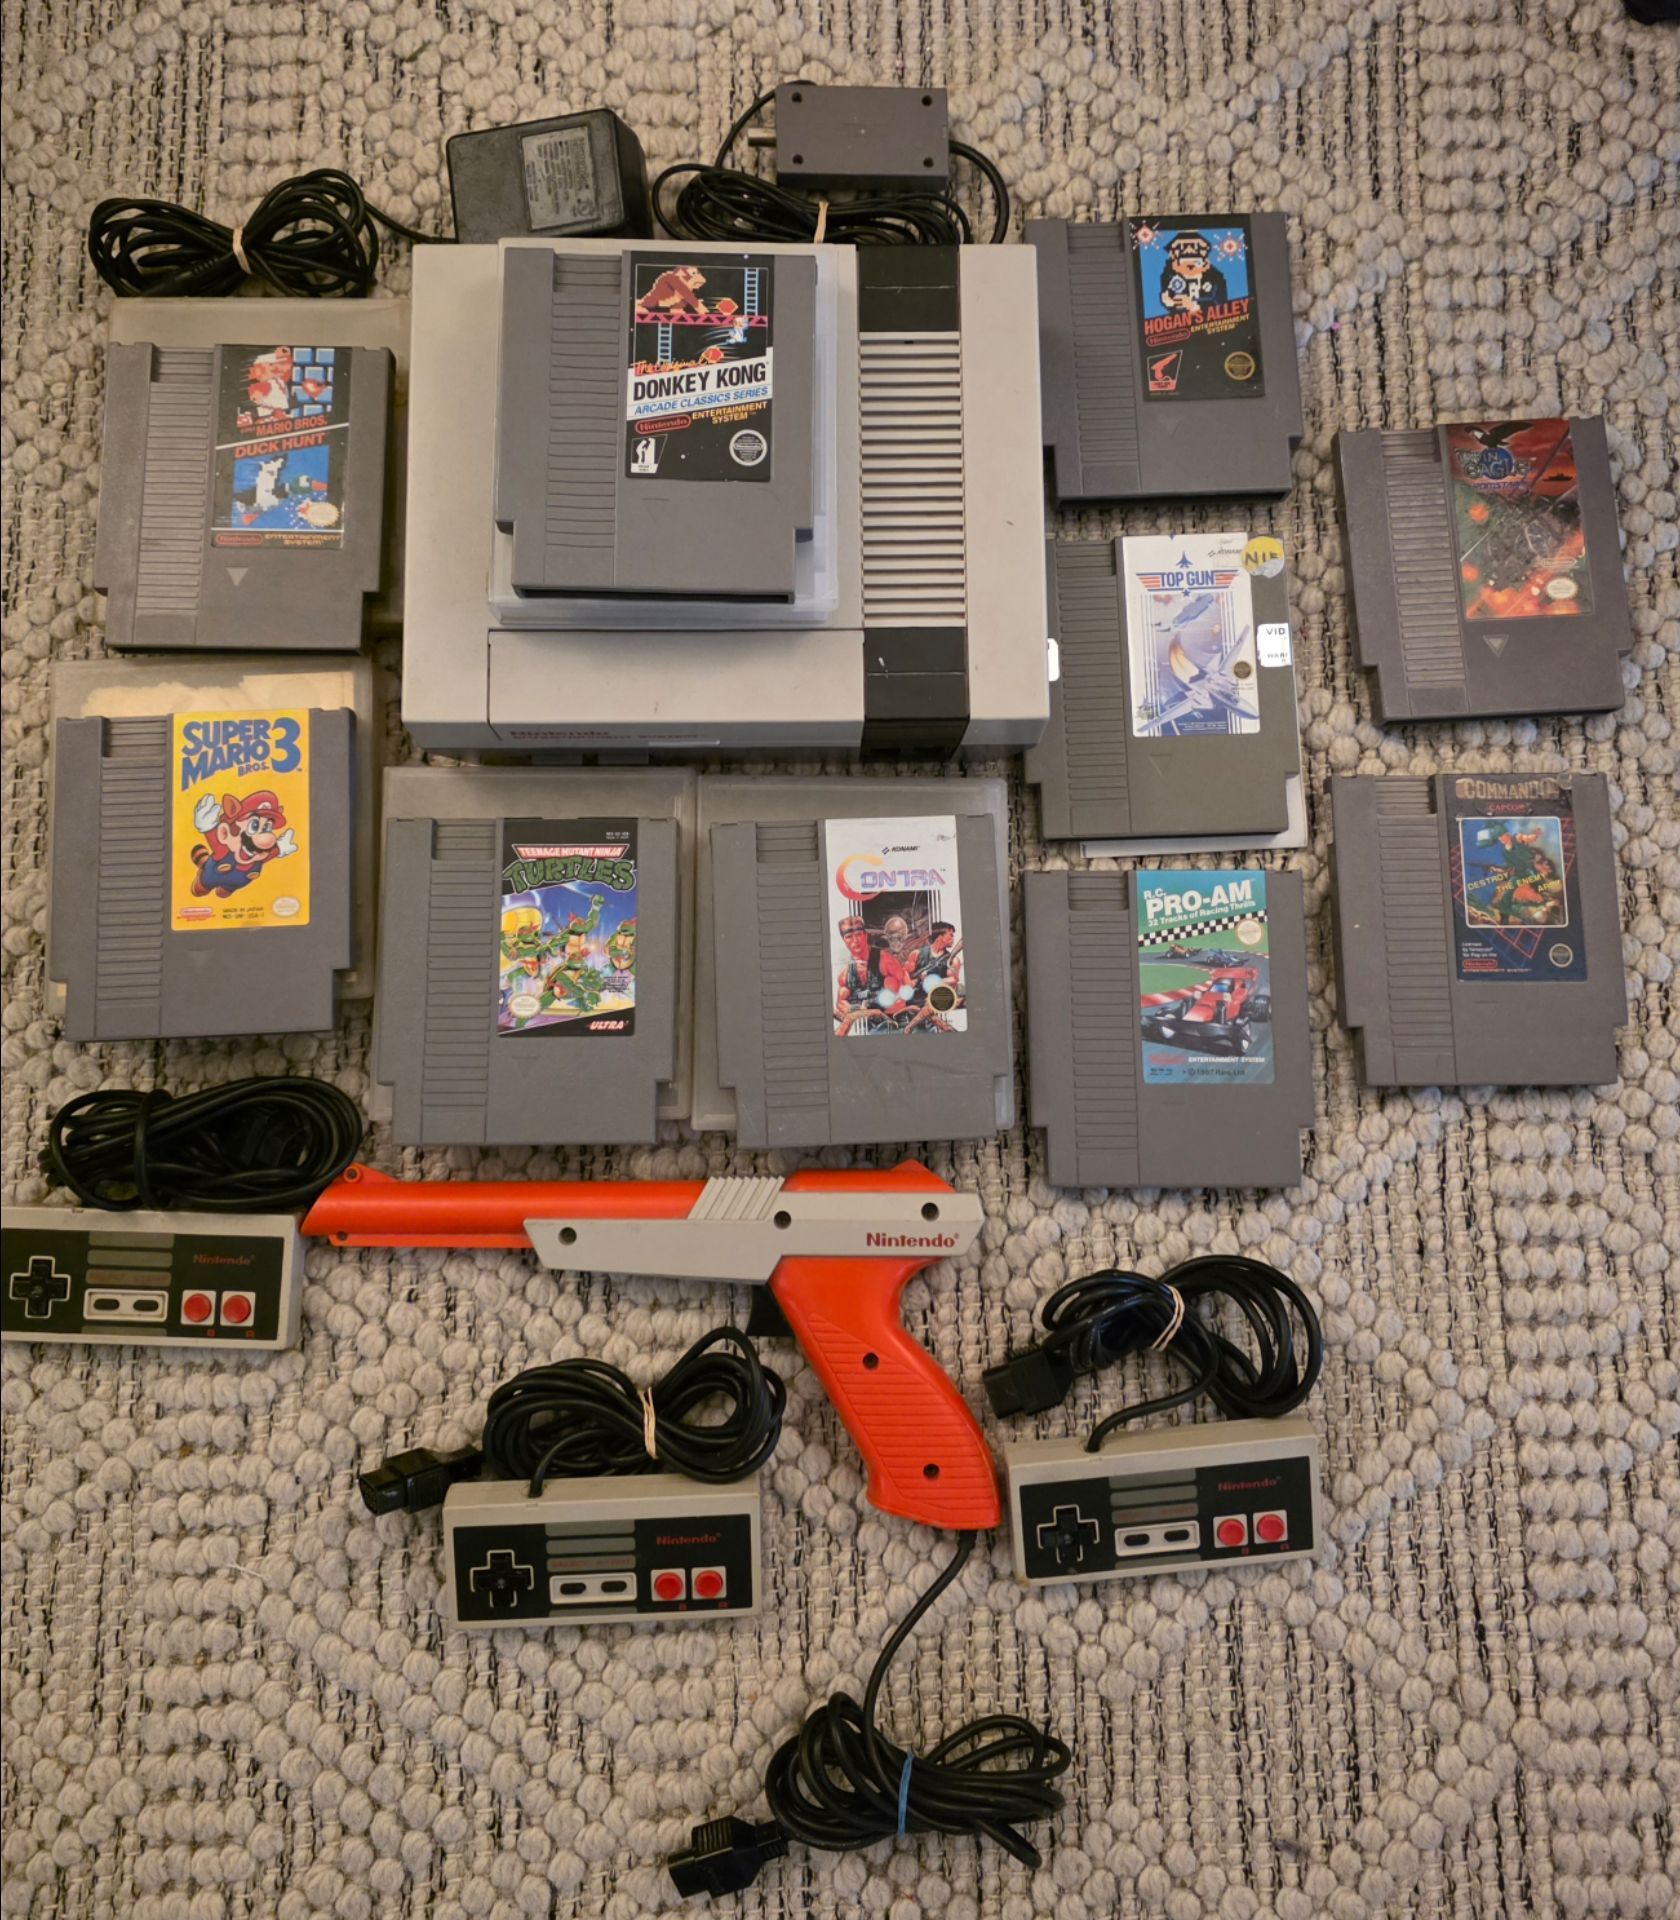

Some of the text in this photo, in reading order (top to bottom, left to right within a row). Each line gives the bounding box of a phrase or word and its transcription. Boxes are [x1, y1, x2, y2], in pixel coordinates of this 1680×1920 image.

[1144, 298, 1249, 335] HOGAN'S ALLEY
[633, 362, 766, 401] DONKEY KONG
[634, 385, 768, 416] ARCADE CLASSICS SERIES
[692, 400, 768, 420] ENTERTAINMENT
[711, 412, 748, 425] SYSTEM
[256, 415, 328, 437] MARIO BROS.
[234, 432, 325, 459] DUCK HUNT
[1160, 570, 1214, 587] TOP GUN
[181, 717, 302, 773] SUPER 3
[181, 738, 270, 792] MARIO
[237, 761, 270, 777] BROS.
[520, 846, 623, 857] TEENAGE MUTANT NINJA
[502, 855, 635, 894] TURTLES
[836, 853, 946, 901] CONTRA
[1467, 872, 1508, 890] DESTROY
[1143, 887, 1167, 900] R.C.
[1146, 879, 1252, 920] PRO-AM
[1161, 913, 1188, 925] Tracks
[1200, 907, 1229, 917] Racing
[589, 1020, 625, 1031] ULTRA
[866, 1232, 956, 1248] Nintendo
[193, 1254, 251, 1265] Nintendo
[1218, 1478, 1277, 1492] Nintendo
[656, 1534, 717, 1546] Nintendo
